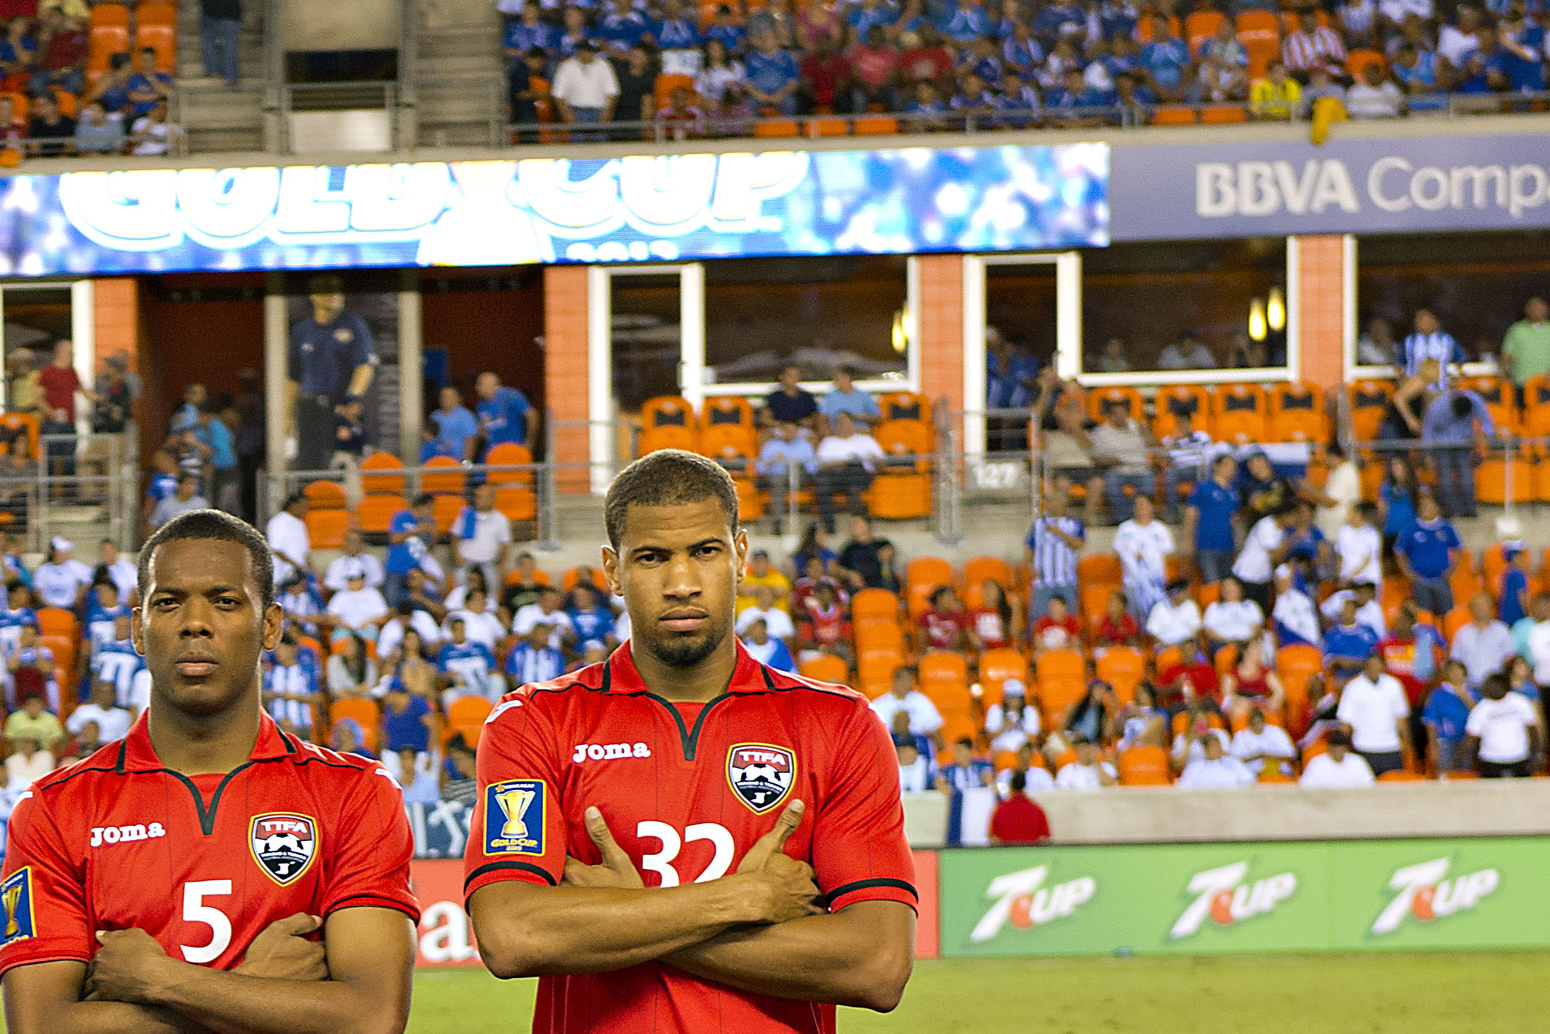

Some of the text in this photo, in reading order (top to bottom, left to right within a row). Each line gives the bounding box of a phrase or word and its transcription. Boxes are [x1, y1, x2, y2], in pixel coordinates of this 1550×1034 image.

[1196, 157, 1550, 219] BBVA Comp
[572, 741, 651, 763] Joma
[738, 751, 786, 765] TTFA
[91, 822, 166, 847] Joma
[261, 821, 307, 834] TTFA
[636, 820, 736, 888] 32
[180, 879, 232, 963] 5
